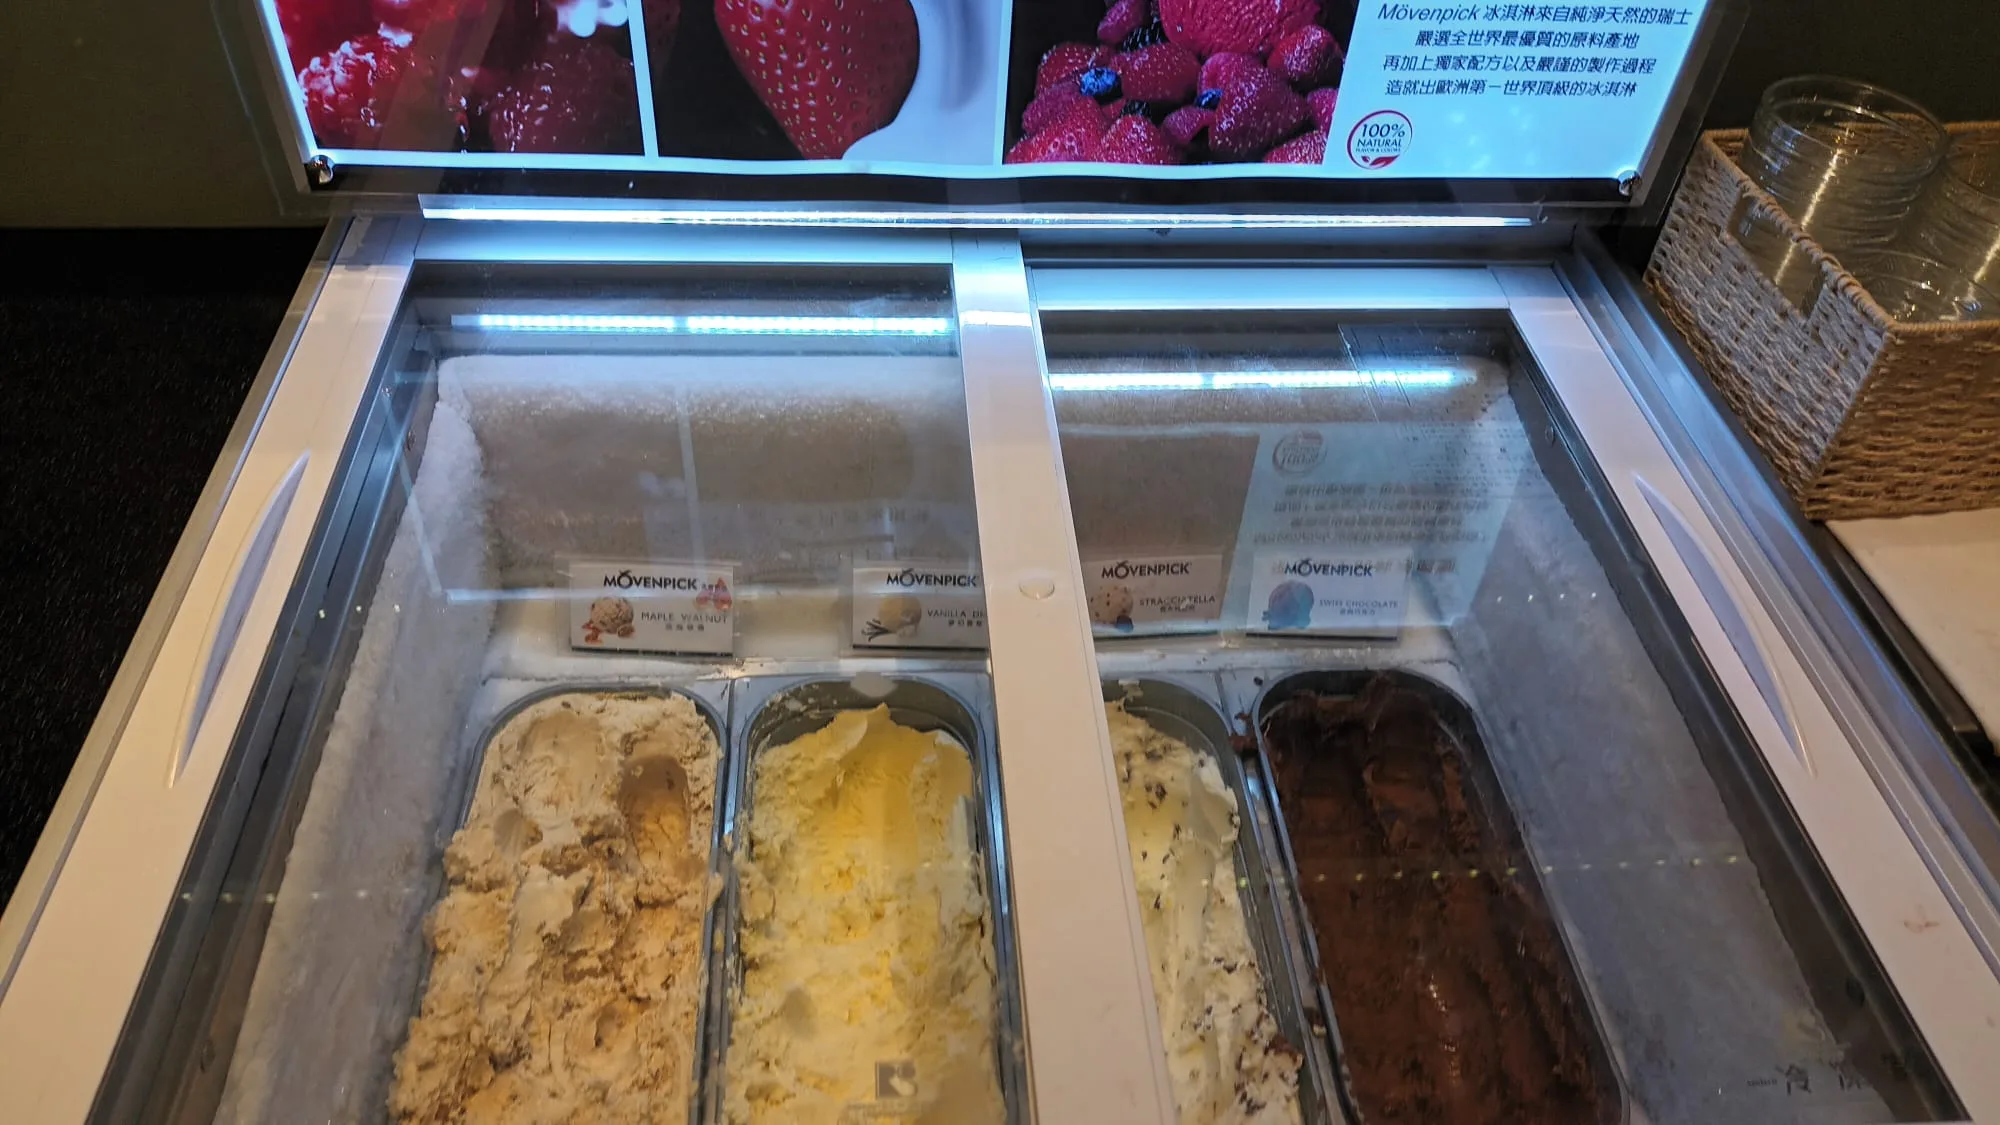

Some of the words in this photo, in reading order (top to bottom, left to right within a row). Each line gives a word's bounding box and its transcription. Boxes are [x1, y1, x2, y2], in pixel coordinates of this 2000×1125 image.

[1377, 3, 1480, 24] Mövenpick
[1483, 4, 1693, 26] 冰淇淋來自純淨天然的瑞士
[1415, 30, 1640, 49] 嚴選全世界最優質的原料產地
[1383, 54, 1657, 75] 再加上獨家配方以及嚴謹的製作過程
[1385, 79, 1638, 98] 造就出歐洲第一世界頂級的冰淇淋
[1362, 123, 1406, 138] 100%
[1357, 139, 1402, 148] NATURAL
[1346, 600, 1399, 609] CHOCOLATE
[641, 611, 674, 622] MAPLE
[681, 612, 728, 625] WALNUT
